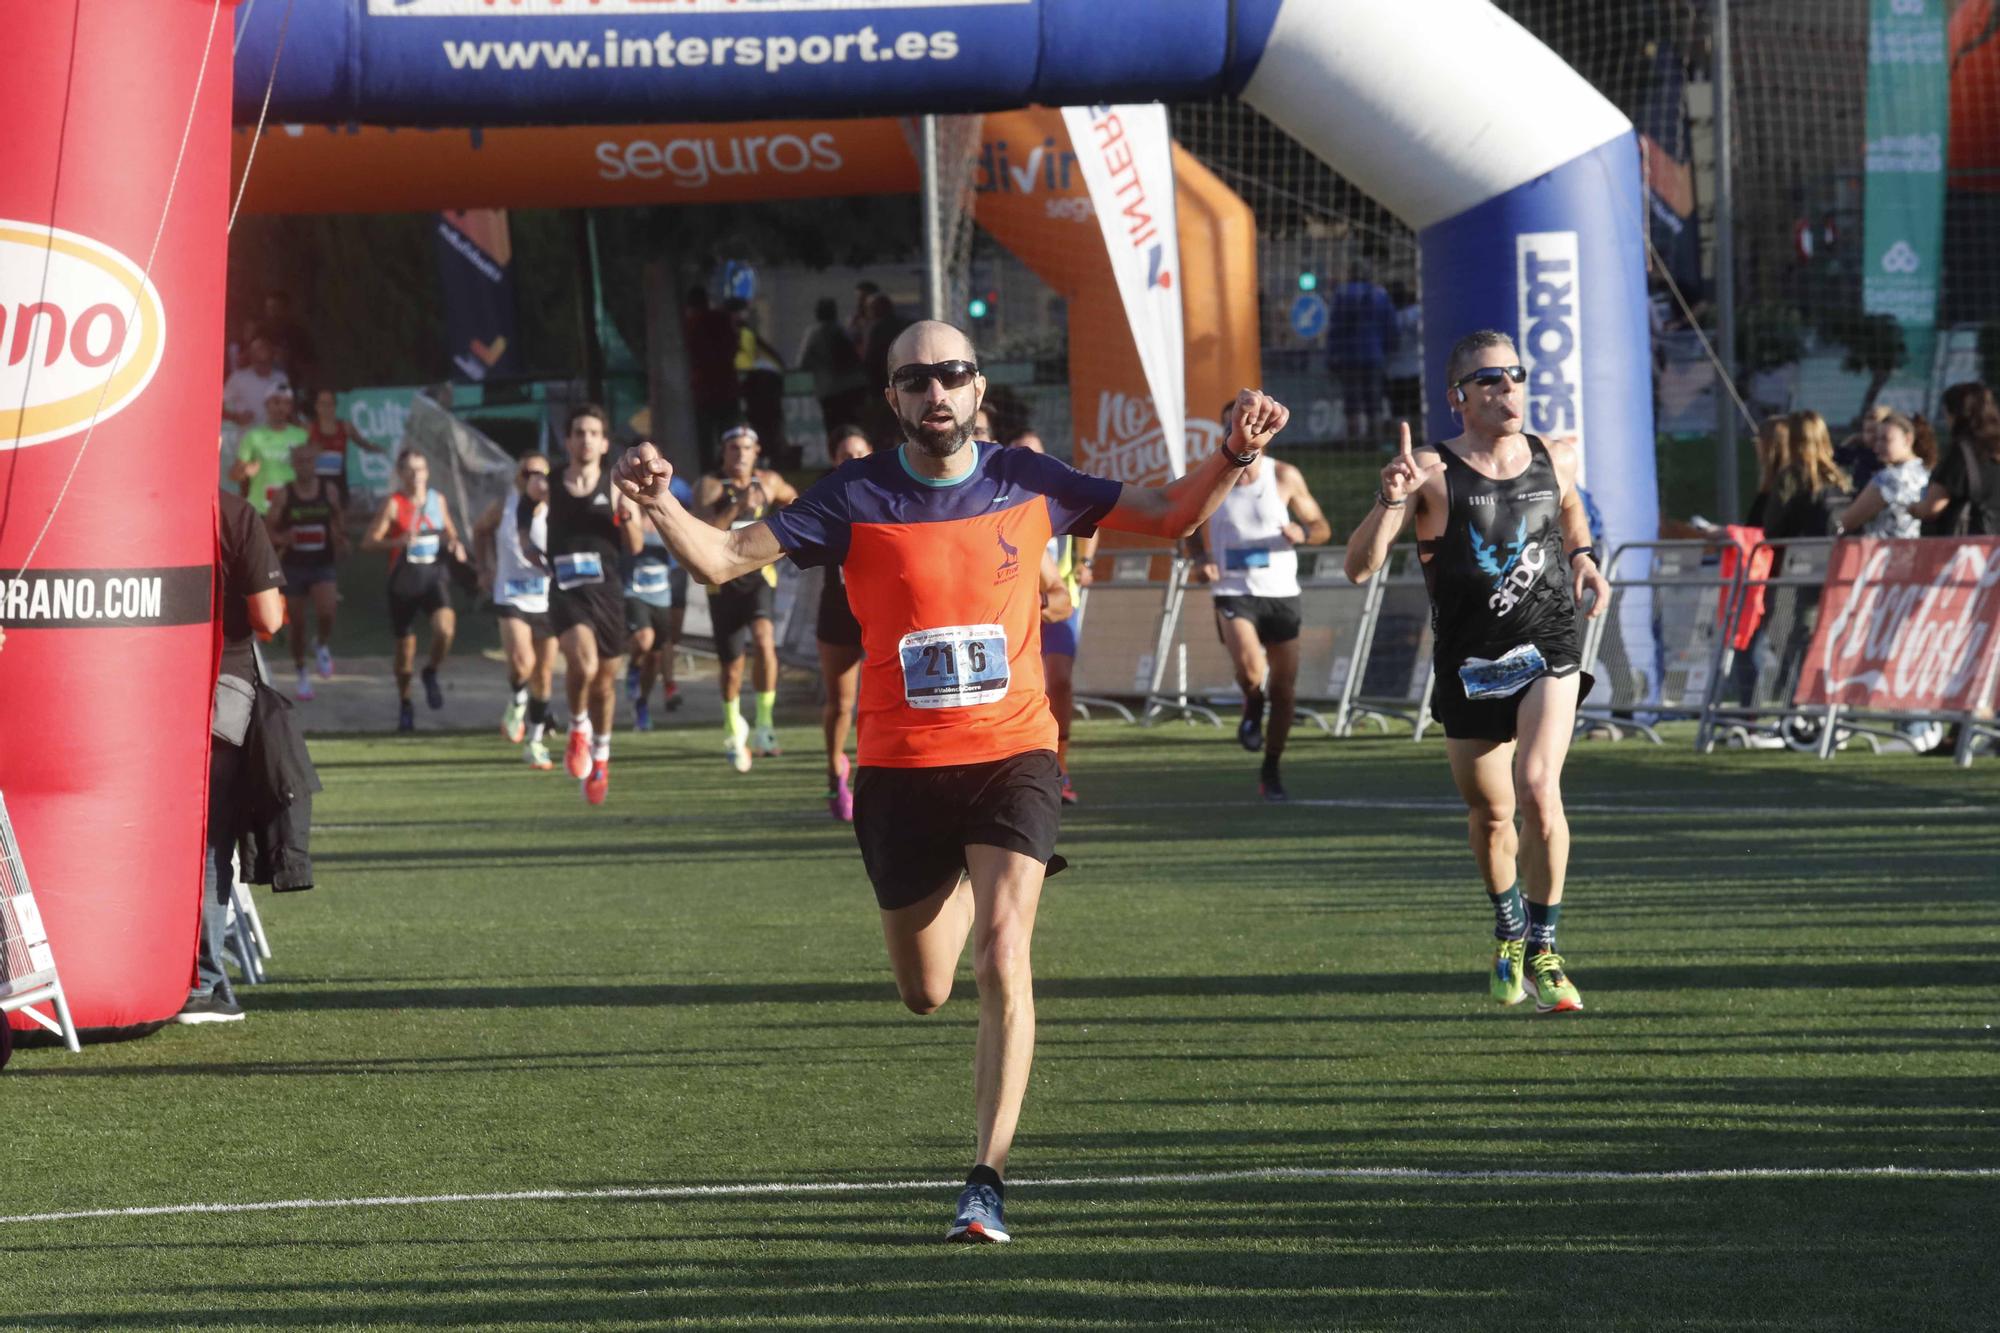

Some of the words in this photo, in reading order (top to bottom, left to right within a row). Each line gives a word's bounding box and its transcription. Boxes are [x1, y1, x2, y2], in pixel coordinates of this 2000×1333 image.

[443, 25, 960, 73] www.intersport.es
[595, 132, 843, 188] seguros
[1526, 250, 1577, 440] SPORT
[922, 641, 987, 676] 216
